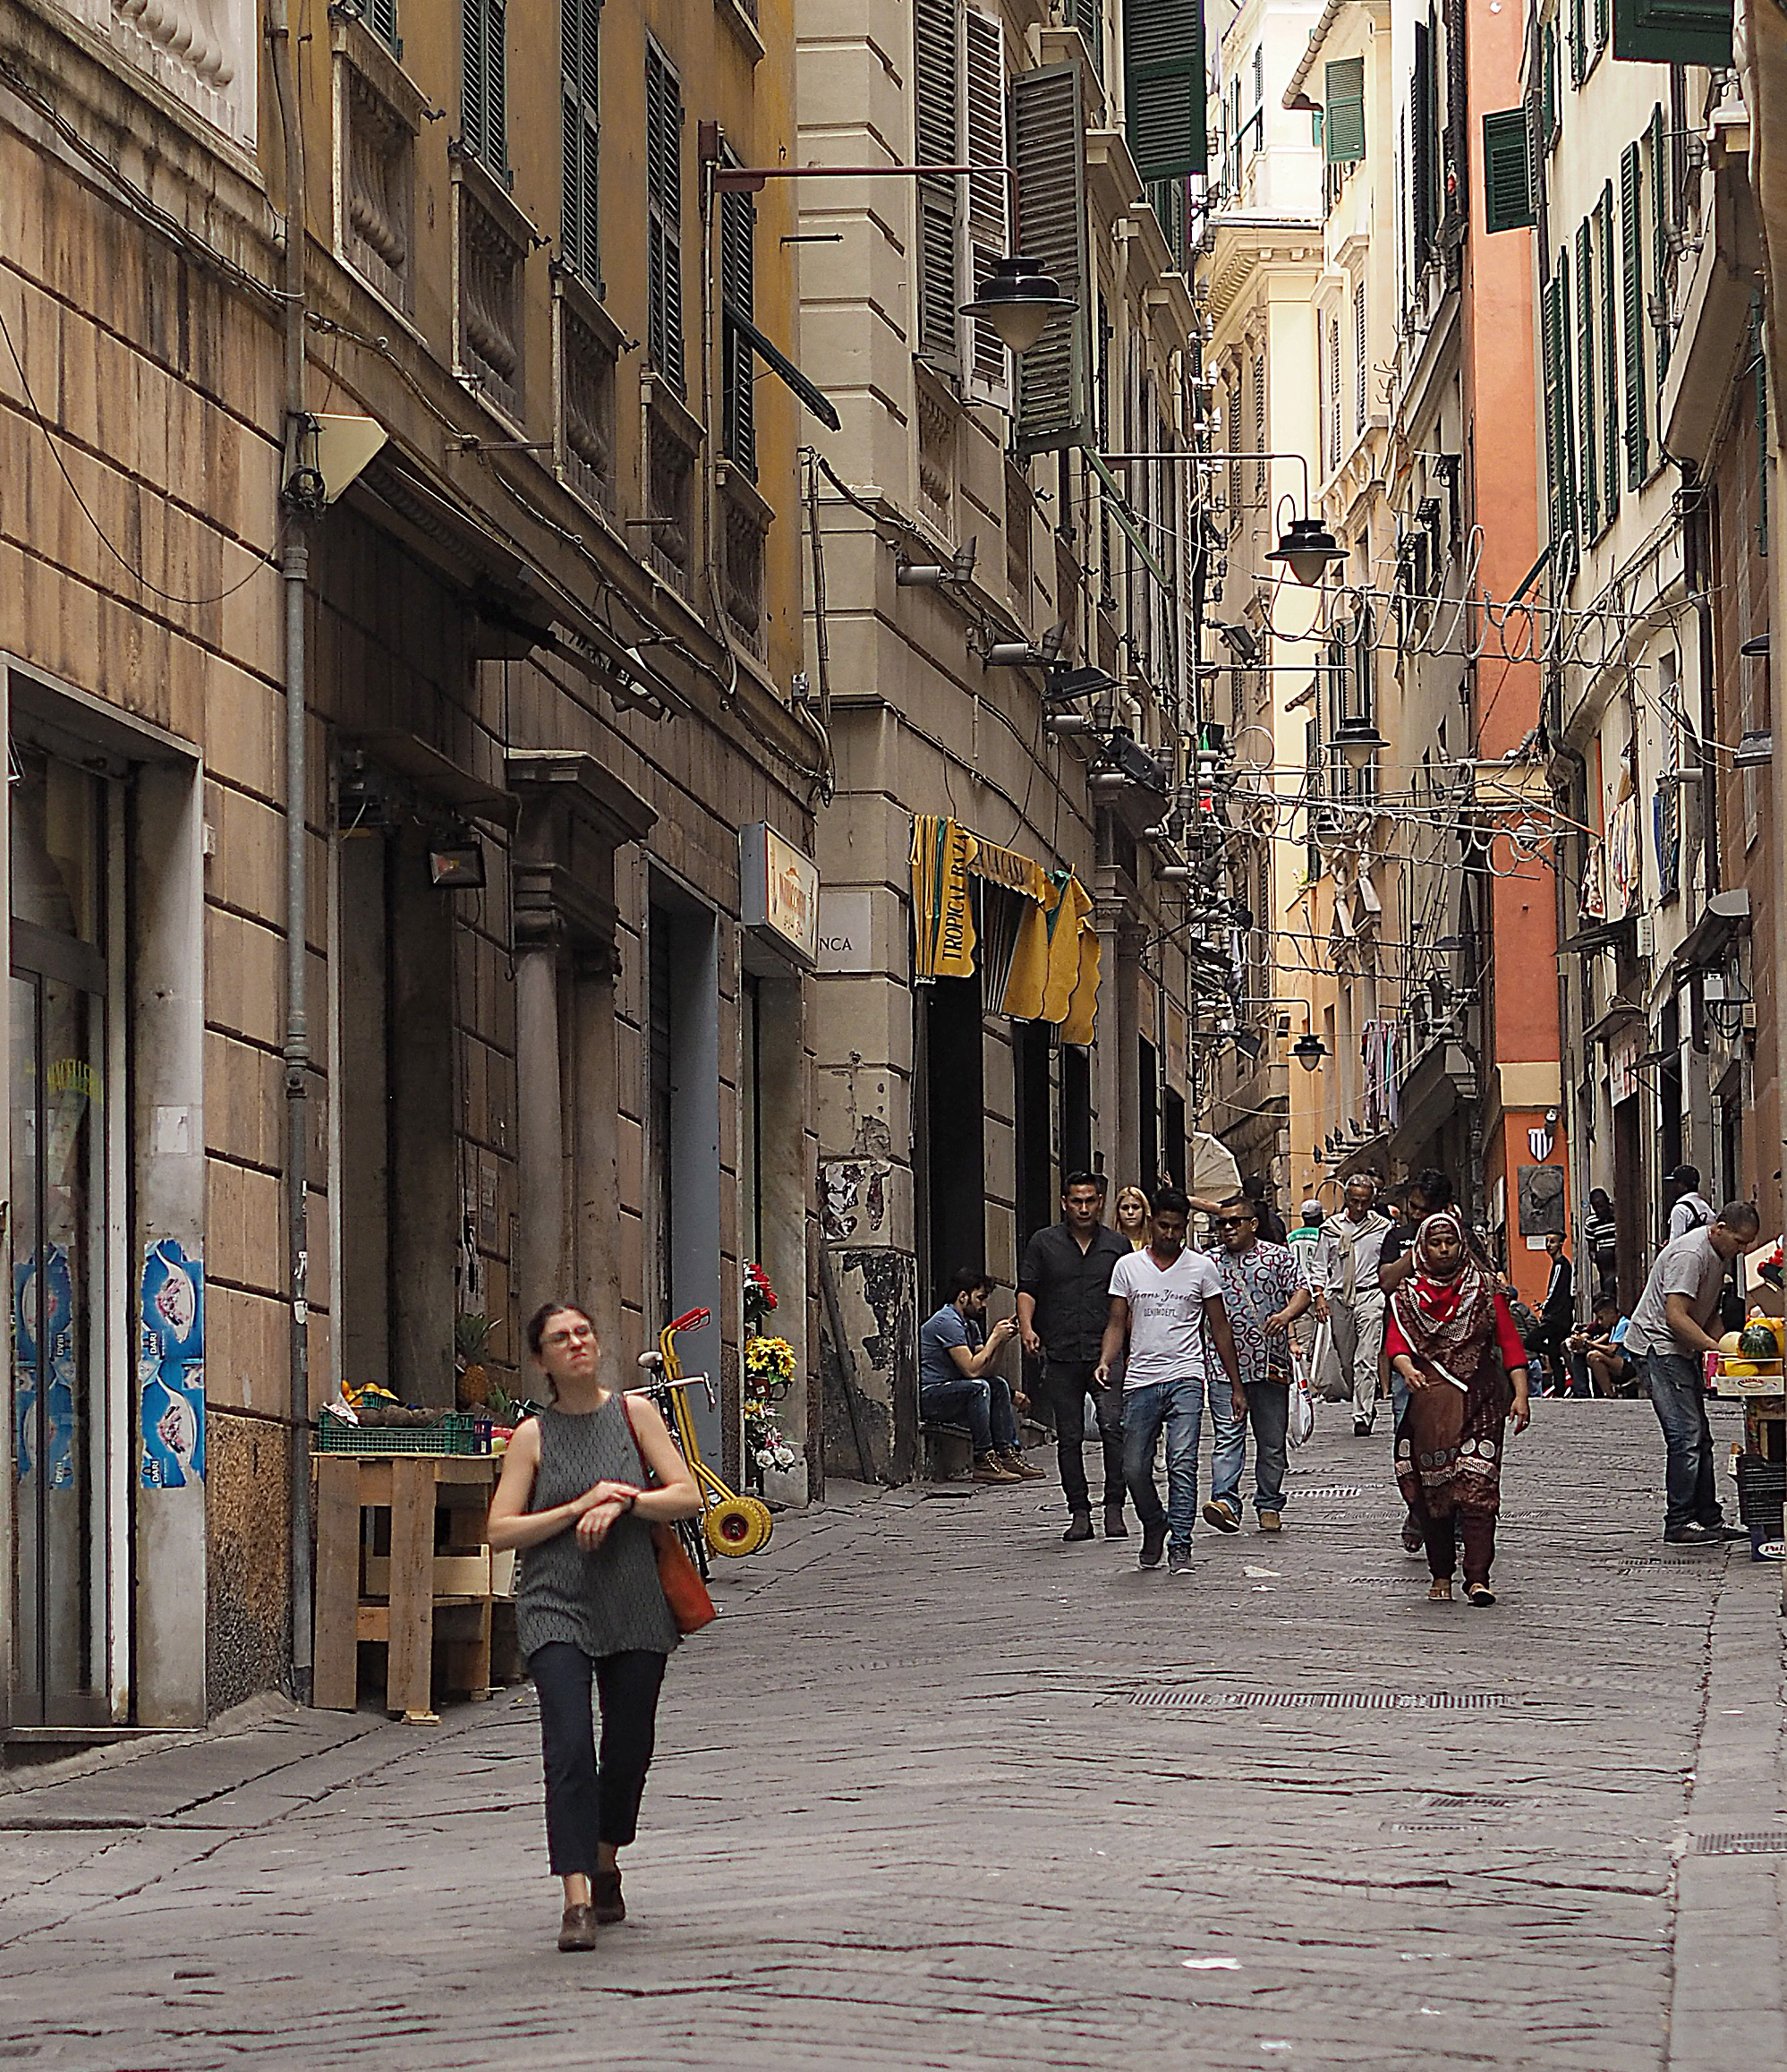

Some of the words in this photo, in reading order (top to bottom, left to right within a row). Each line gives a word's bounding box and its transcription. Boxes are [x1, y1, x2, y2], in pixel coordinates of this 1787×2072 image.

[941, 884, 966, 961] TROPICAL
[149, 1333, 157, 1354] DARI
[151, 1461, 159, 1482] DARI
